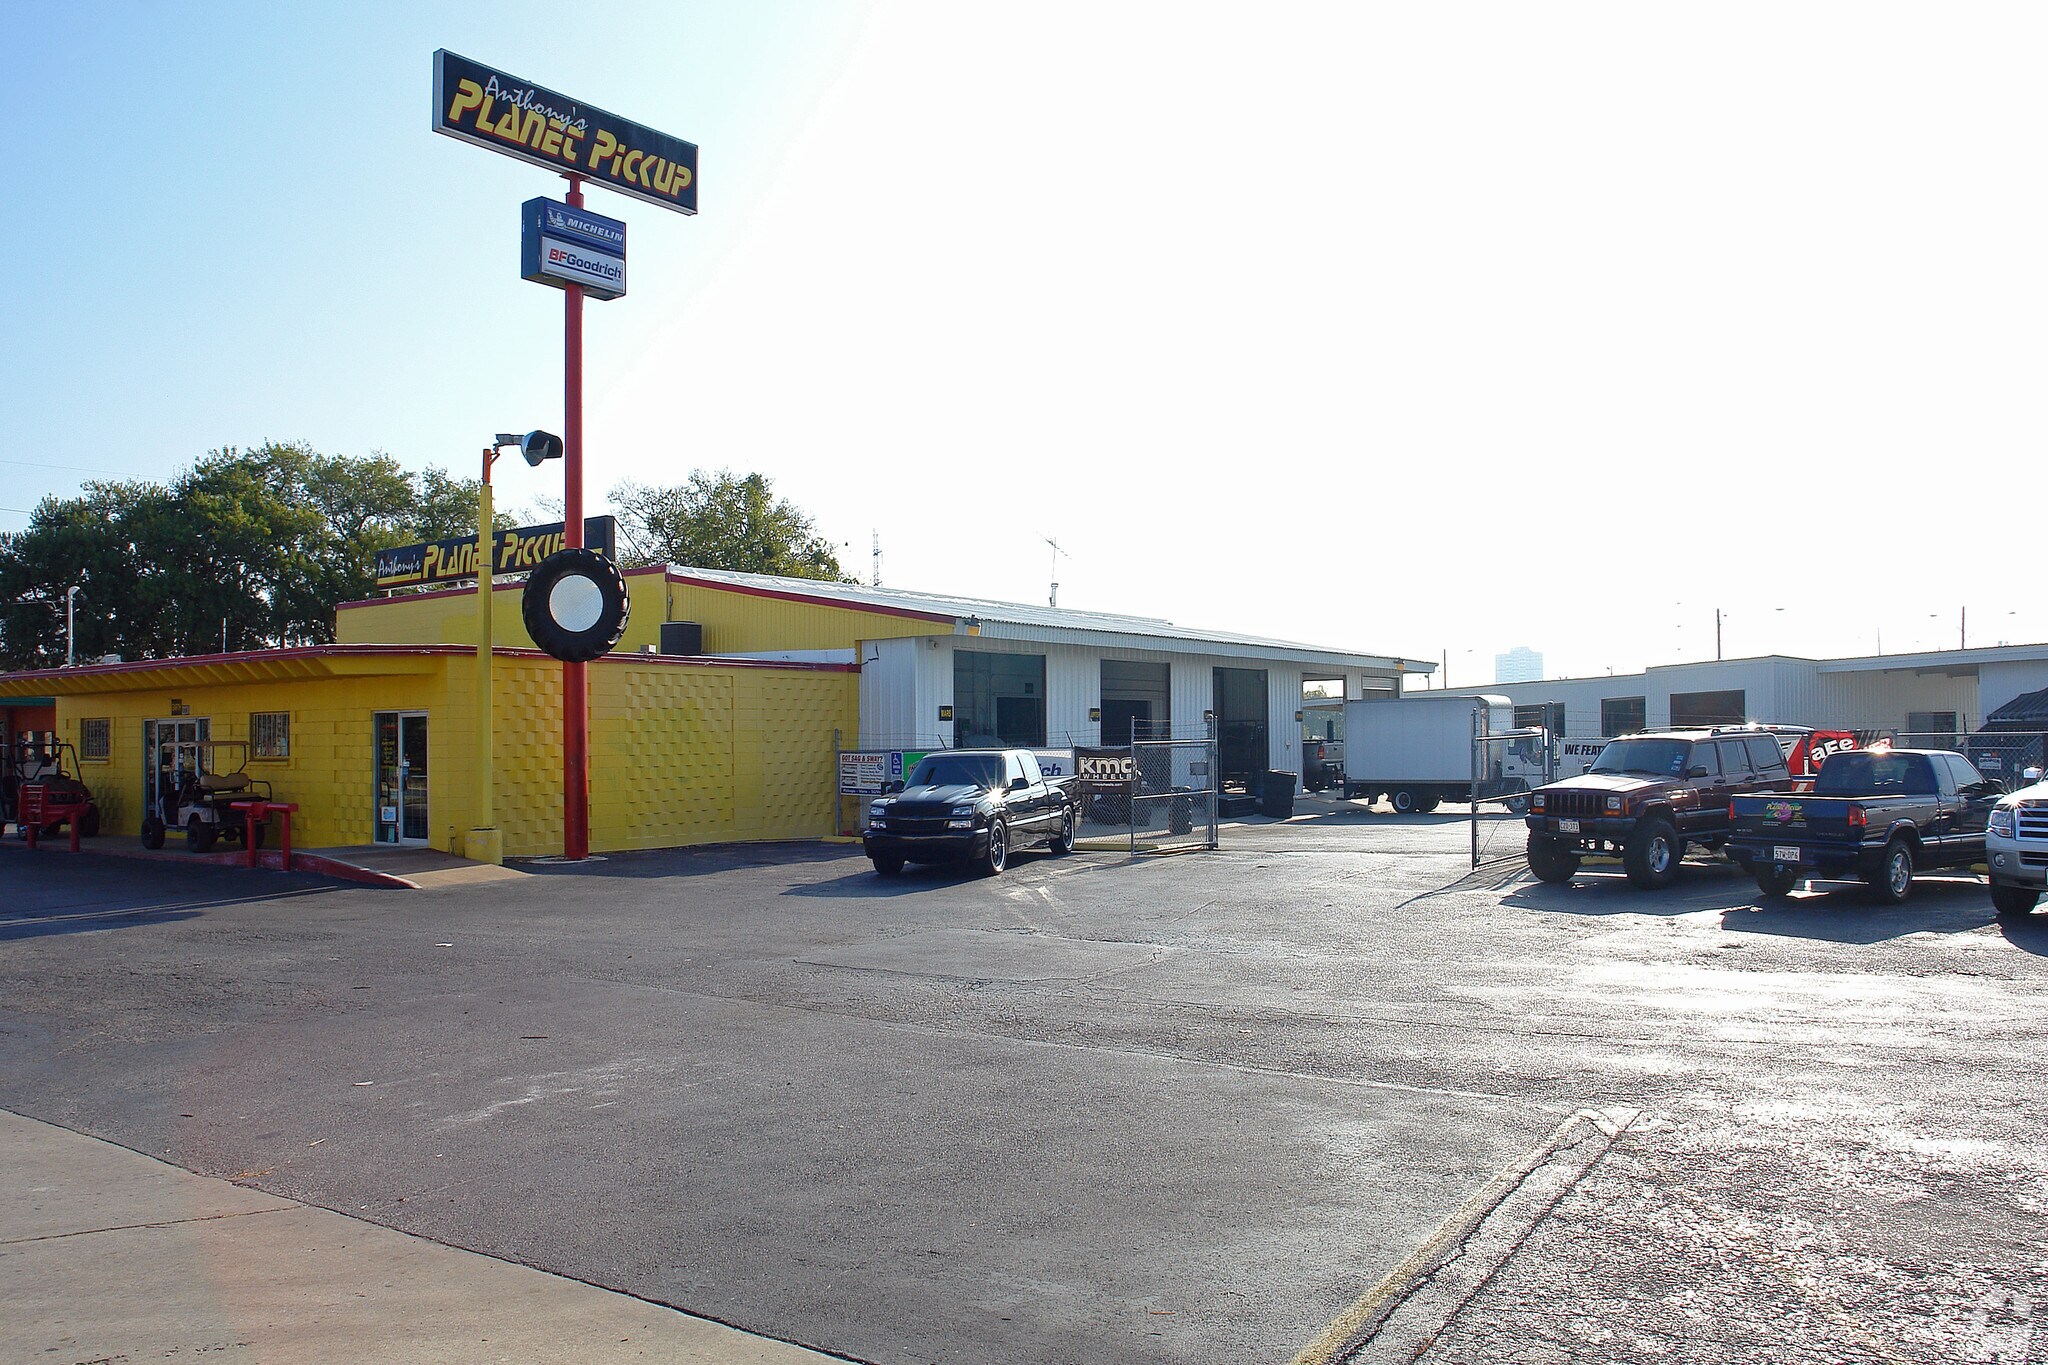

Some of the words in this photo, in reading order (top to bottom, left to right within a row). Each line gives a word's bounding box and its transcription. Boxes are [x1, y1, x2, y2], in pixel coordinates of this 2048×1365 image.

[484, 75, 588, 132] Anthony's
[567, 218, 623, 242] MICHELIN
[549, 248, 622, 279] BFGoodrich
[378, 554, 421, 579] Anthony's
[1564, 744, 1579, 755] WE
